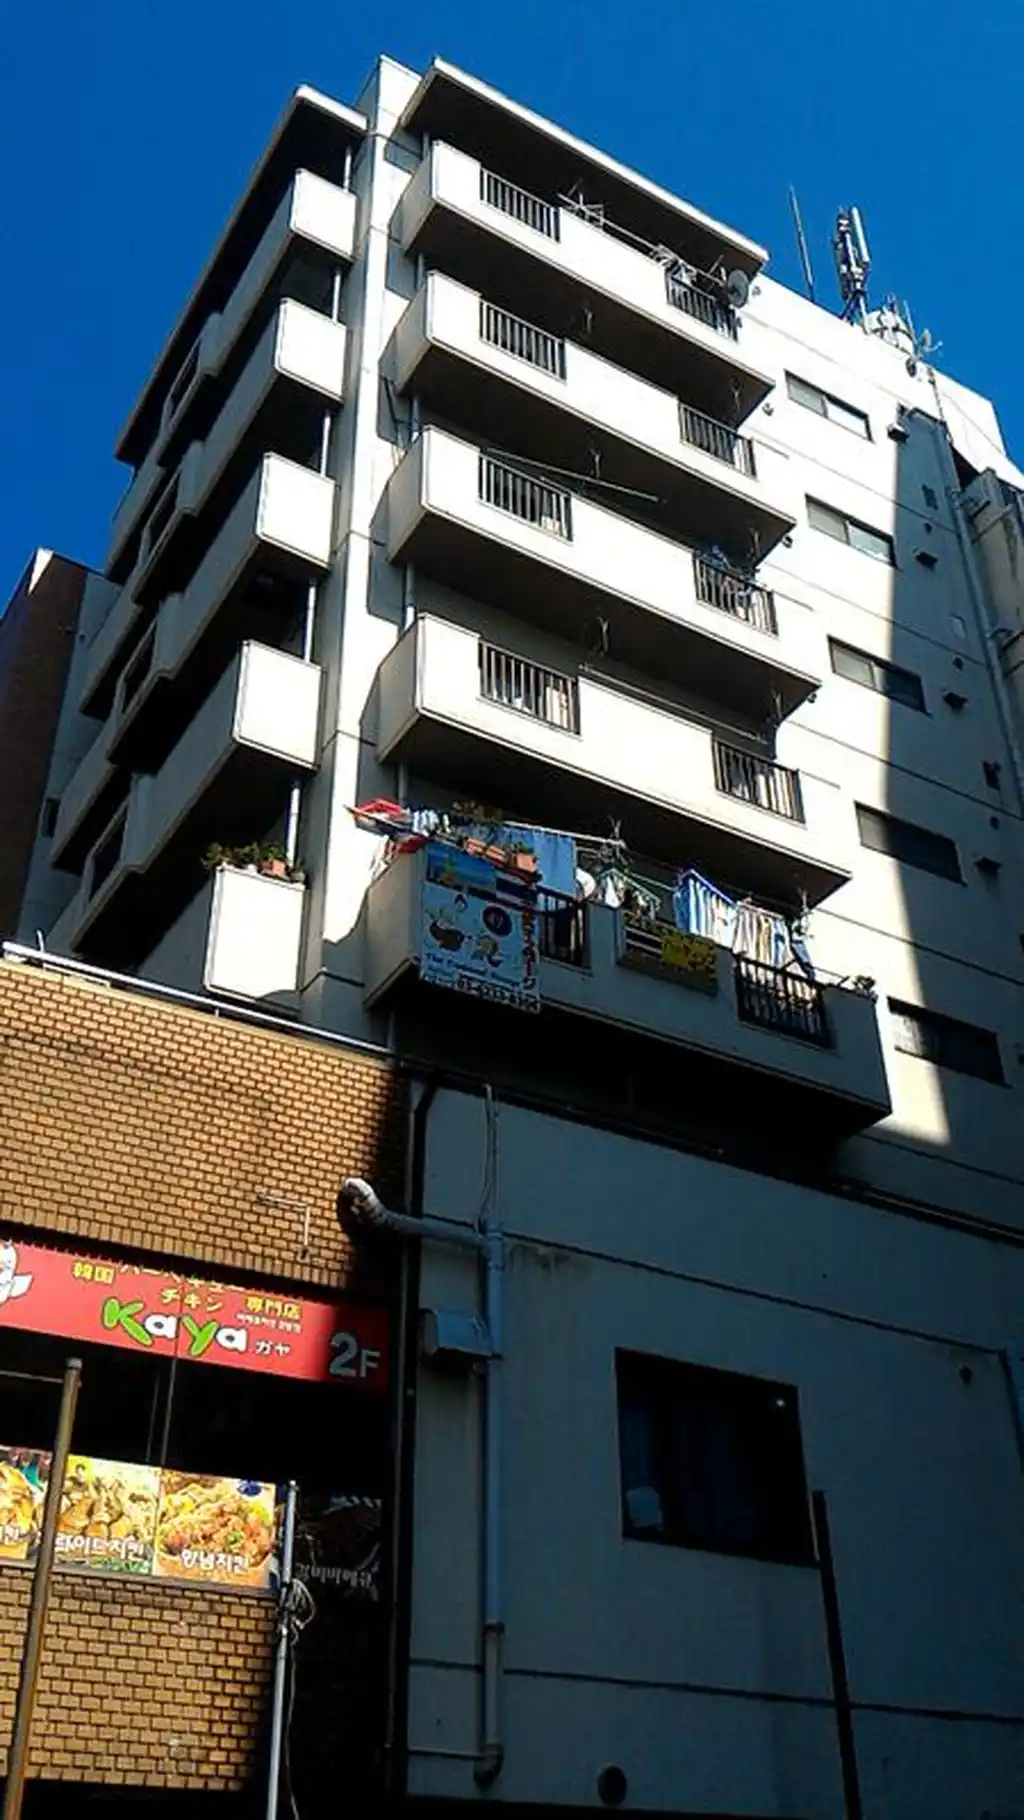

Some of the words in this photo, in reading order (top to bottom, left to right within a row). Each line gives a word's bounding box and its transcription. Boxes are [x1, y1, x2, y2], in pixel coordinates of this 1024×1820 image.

[72, 1260, 115, 1284] 韓国
[245, 1294, 302, 1321] 専門店
[160, 1286, 223, 1313] チキン
[102, 1296, 248, 1357] Kaya
[254, 1340, 291, 1357] ガヤ
[328, 1331, 381, 1378] 2F
